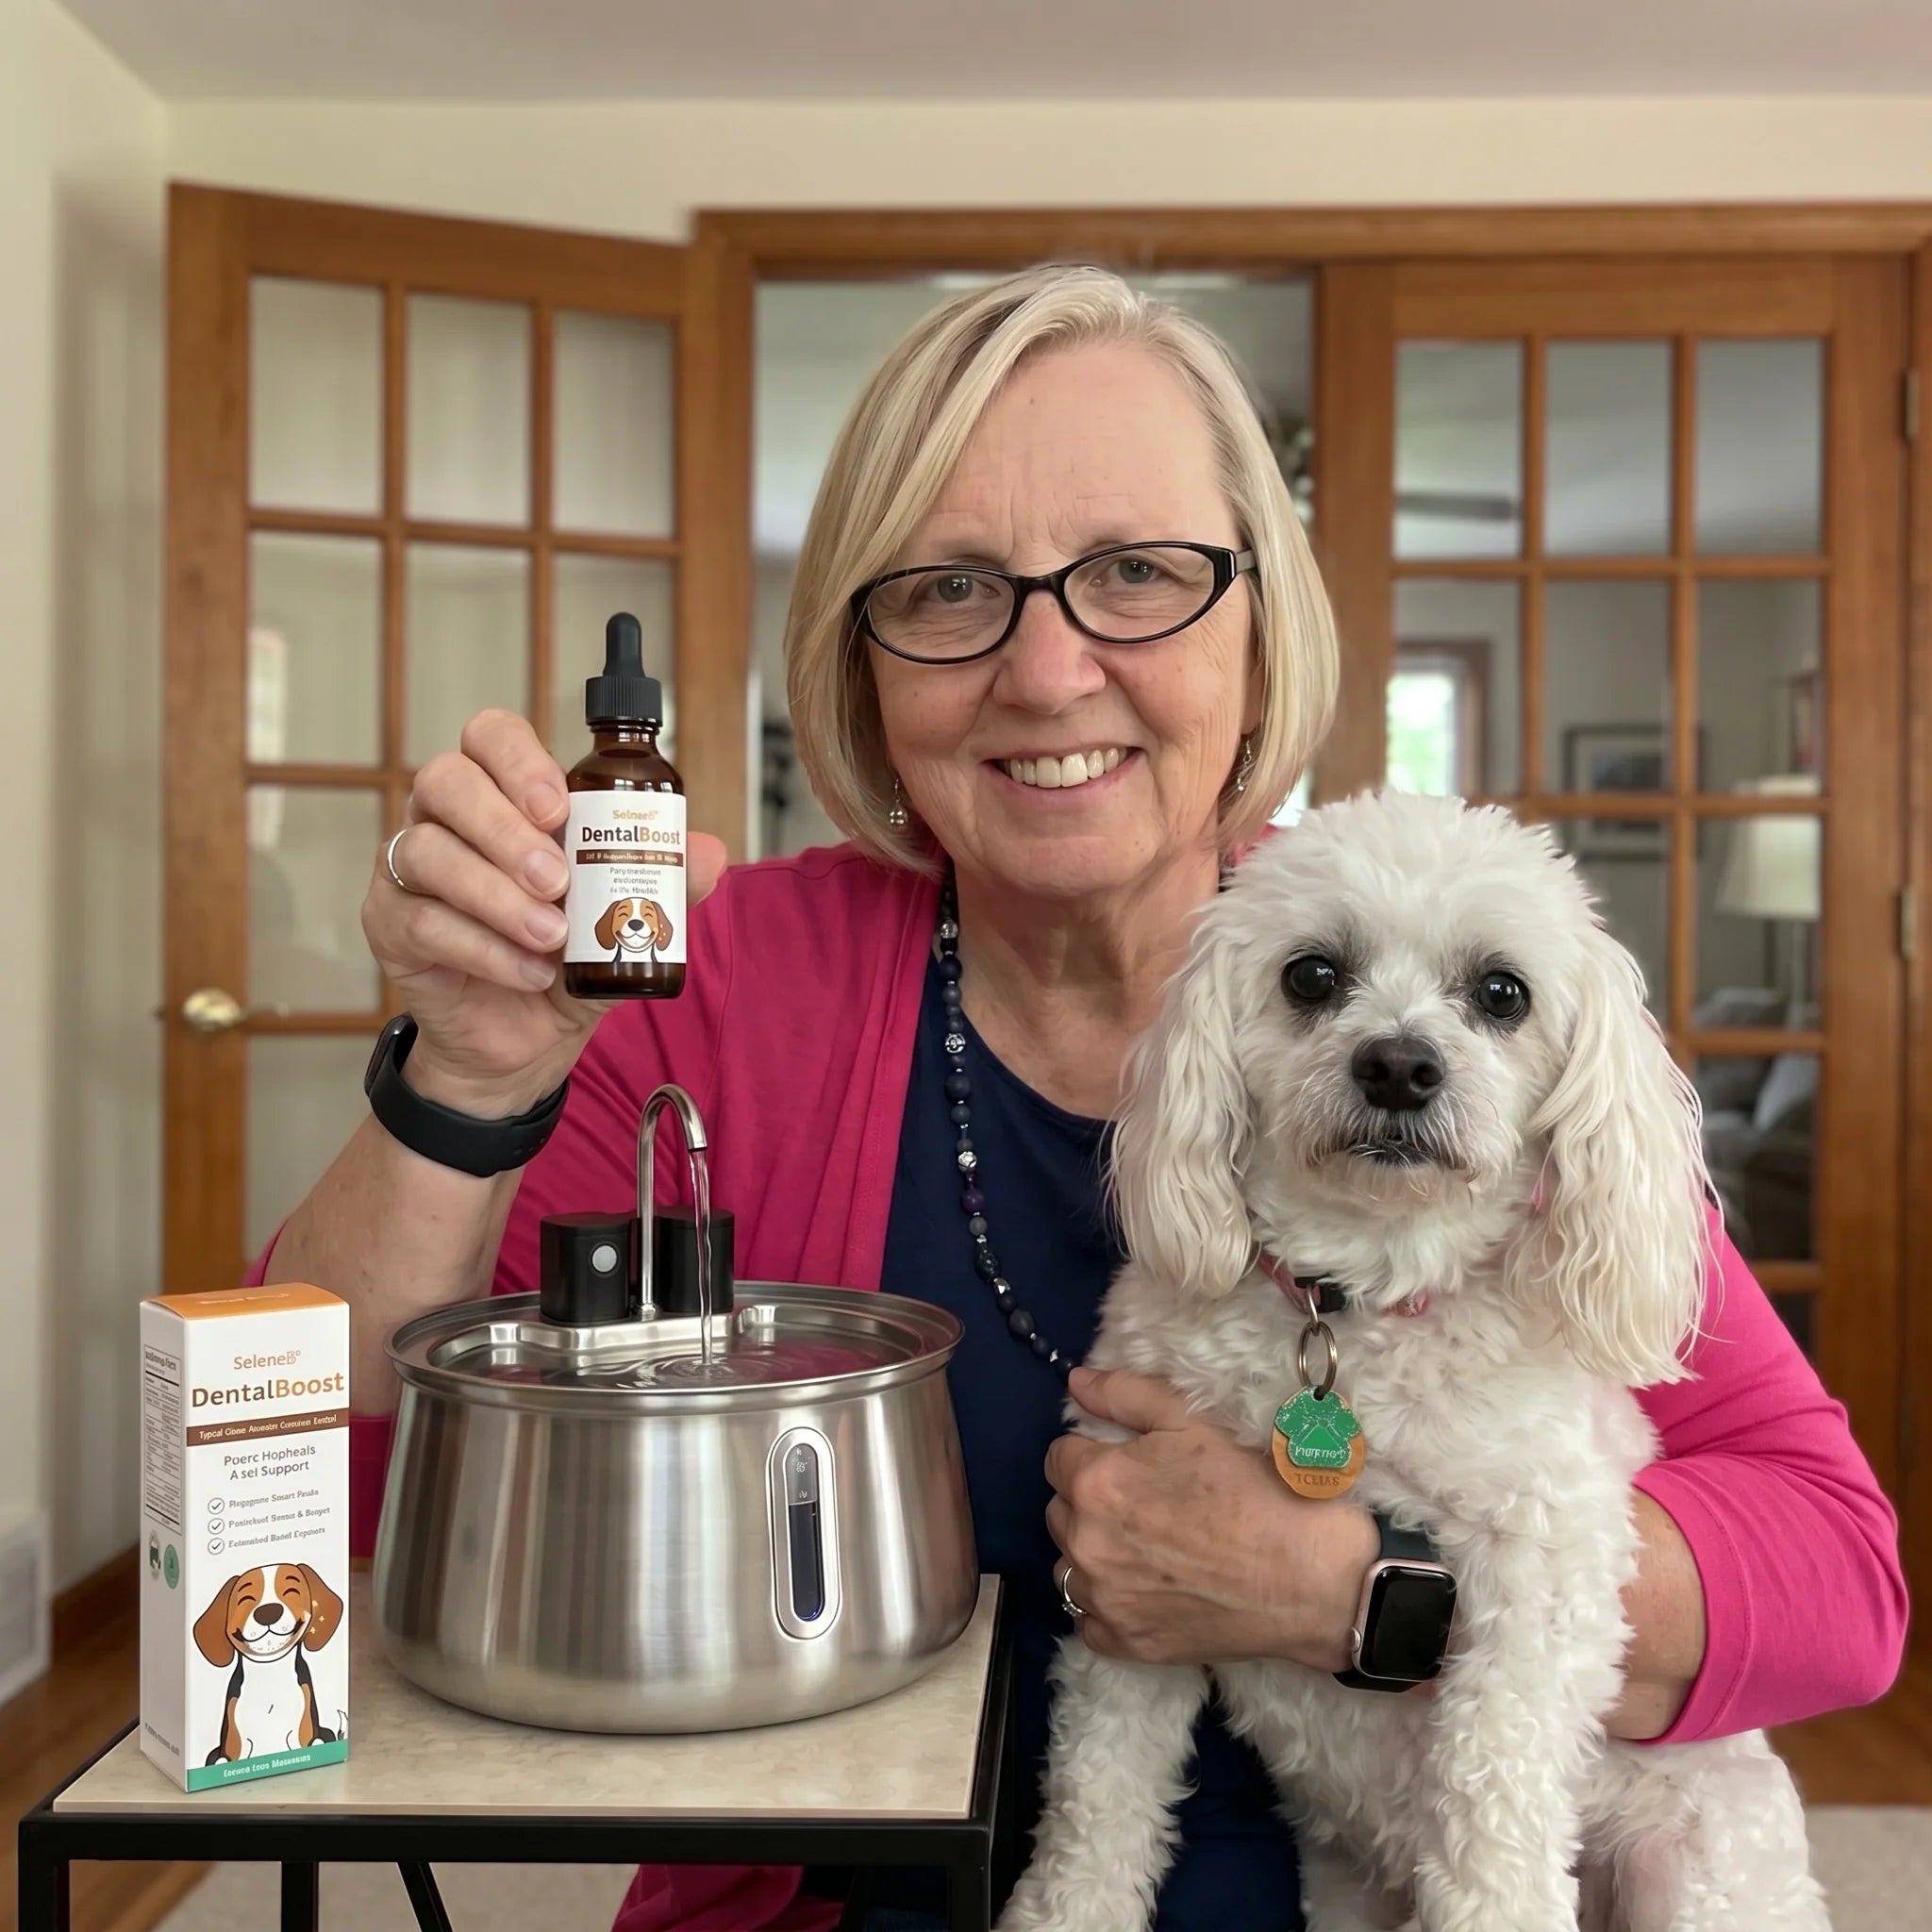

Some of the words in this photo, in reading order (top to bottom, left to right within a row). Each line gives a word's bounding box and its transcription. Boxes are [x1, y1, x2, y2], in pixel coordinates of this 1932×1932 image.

[582, 825, 680, 845] DentalBoost
[192, 1373, 344, 1407] DentalBoost
[262, 1445, 316, 1461] Hopheals
[229, 1470, 238, 1480] A
[261, 1461, 309, 1476] Support
